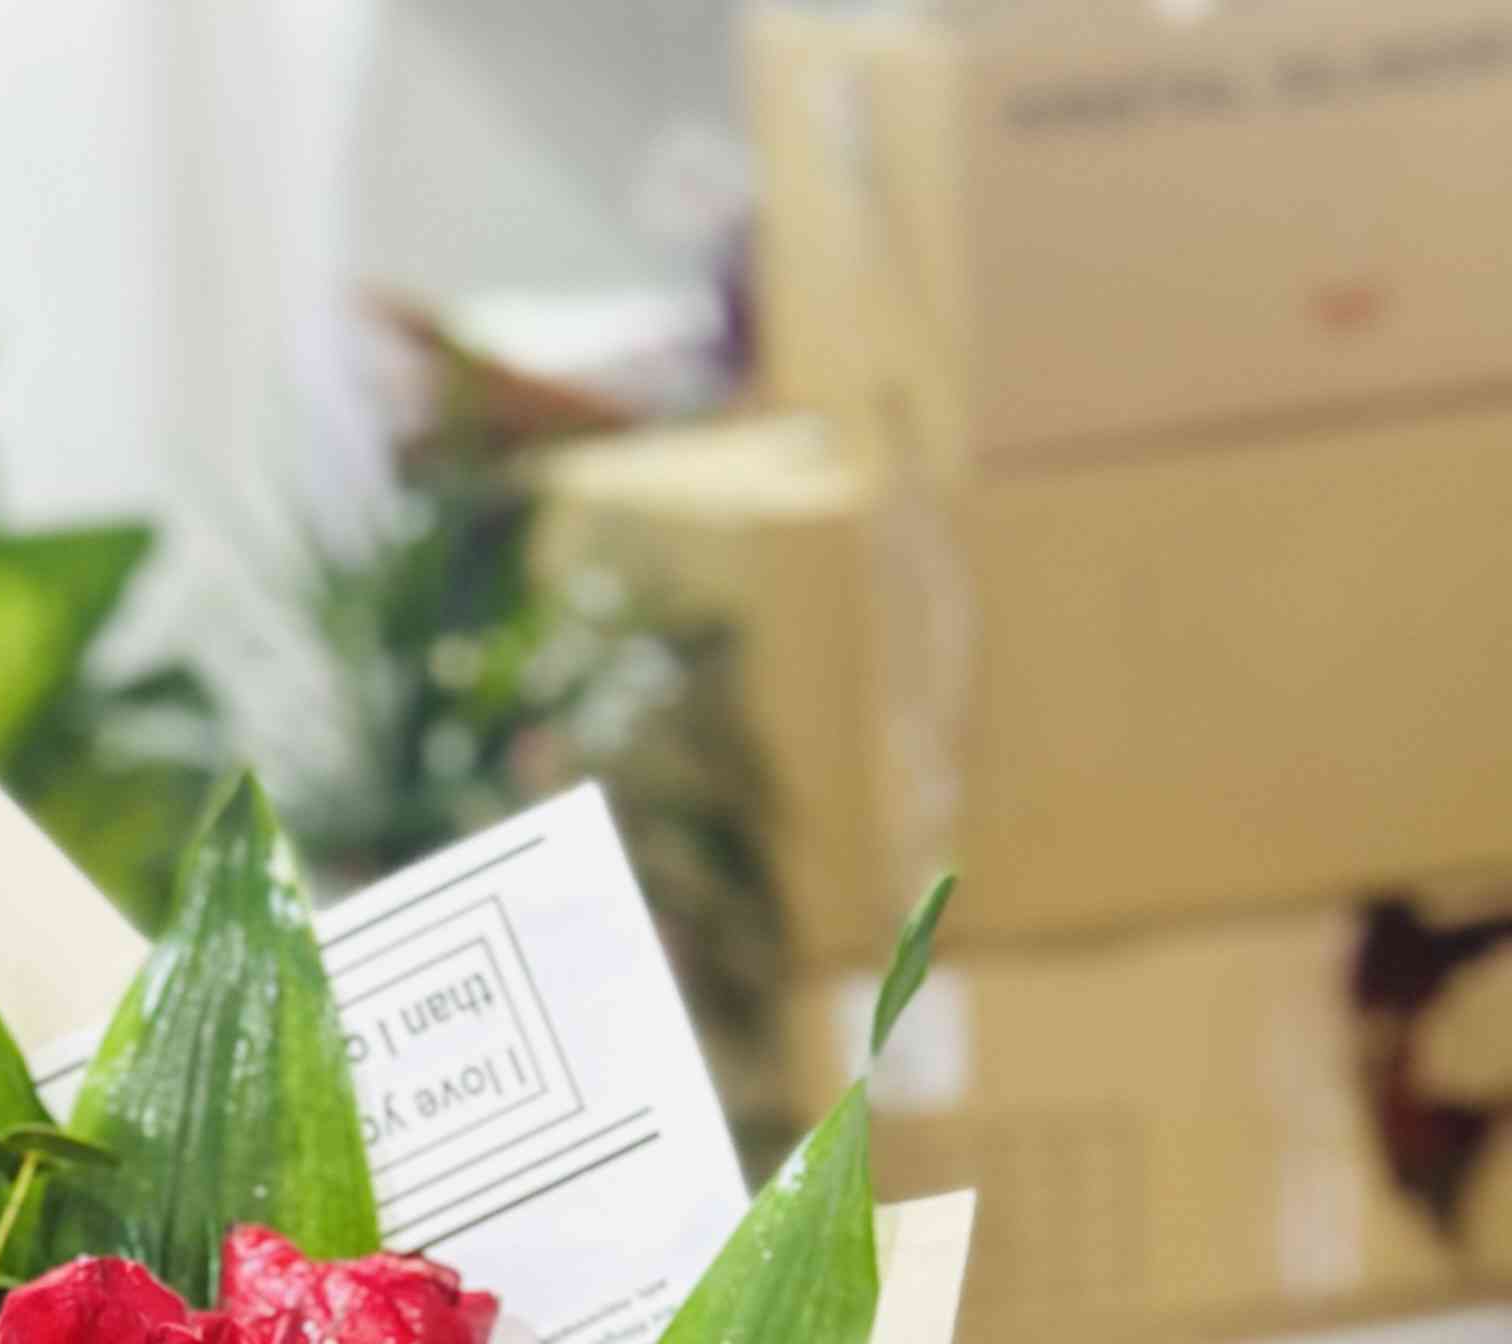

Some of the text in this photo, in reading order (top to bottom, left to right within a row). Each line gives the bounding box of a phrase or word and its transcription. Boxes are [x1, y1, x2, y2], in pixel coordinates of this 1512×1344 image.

[399, 971, 494, 1036] than
[375, 1018, 399, 1056] I
[412, 1057, 505, 1119] love
[506, 1044, 527, 1085] I
